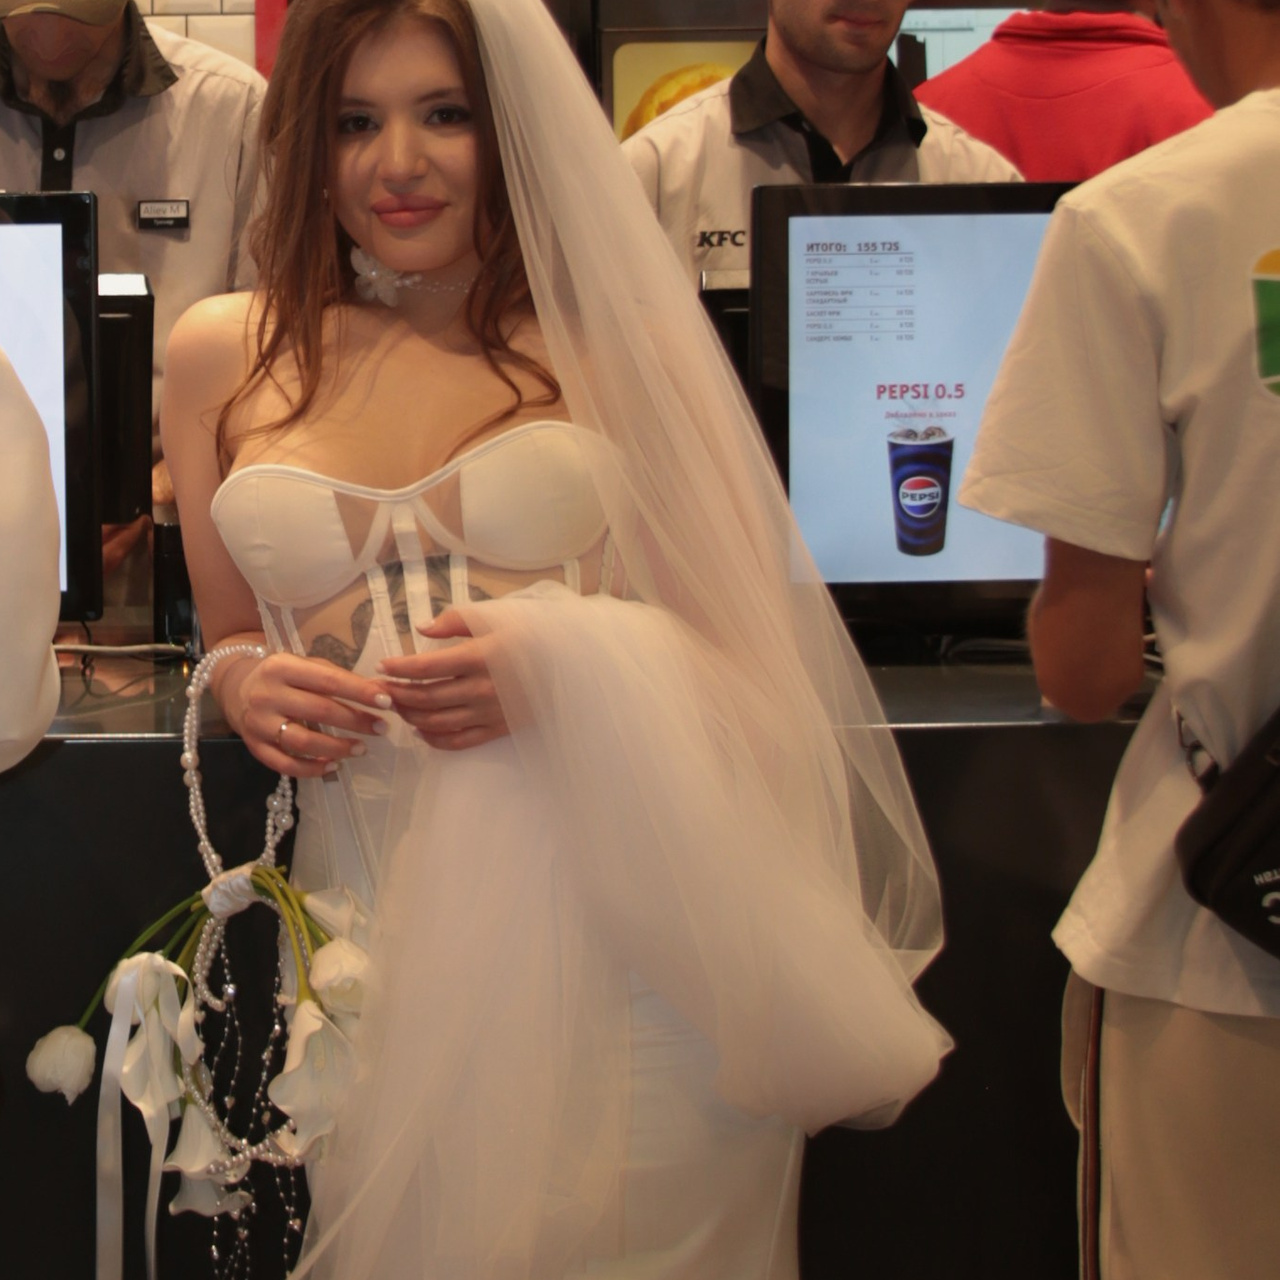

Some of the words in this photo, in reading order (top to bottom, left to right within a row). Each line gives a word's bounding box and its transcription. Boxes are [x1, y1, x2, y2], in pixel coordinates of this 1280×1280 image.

[697, 230, 746, 248] KFC
[806, 242, 847, 253] ИТОГО:
[857, 242, 877, 252] 155
[880, 241, 900, 252] TJS
[876, 384, 929, 400] PEPSI
[934, 383, 964, 400] 0.5
[902, 491, 939, 502] PEPSI
